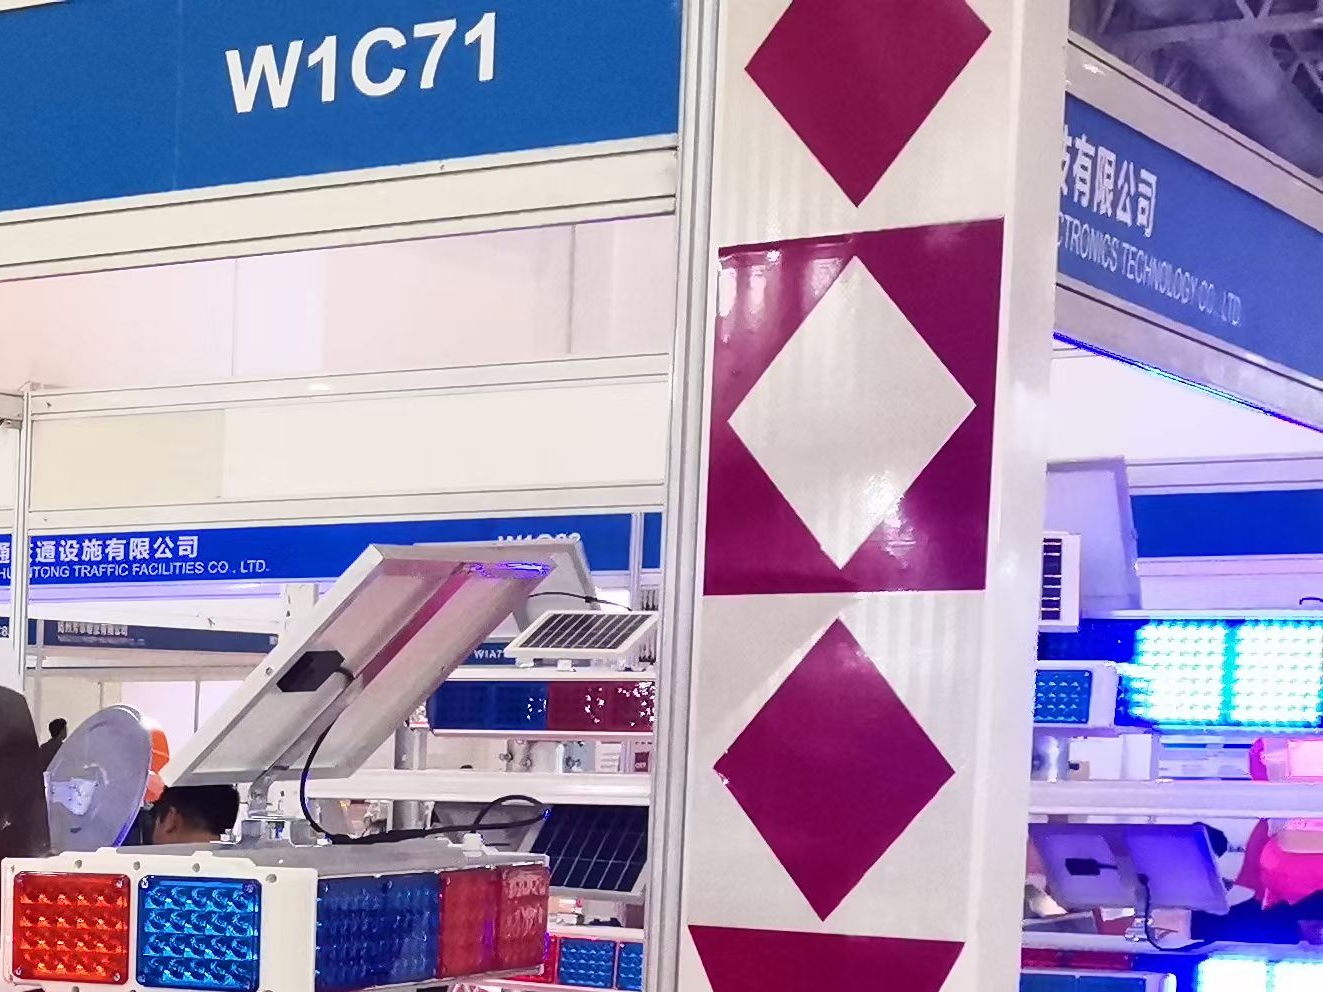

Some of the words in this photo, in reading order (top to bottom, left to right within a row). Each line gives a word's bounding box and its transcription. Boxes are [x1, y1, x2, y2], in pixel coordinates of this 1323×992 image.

[225, 12, 497, 114] W1C71
[1121, 242, 1199, 304] TECHNOLOGY
[73, 563, 129, 577] TRAFFIC
[132, 561, 205, 576] FACILITIES
